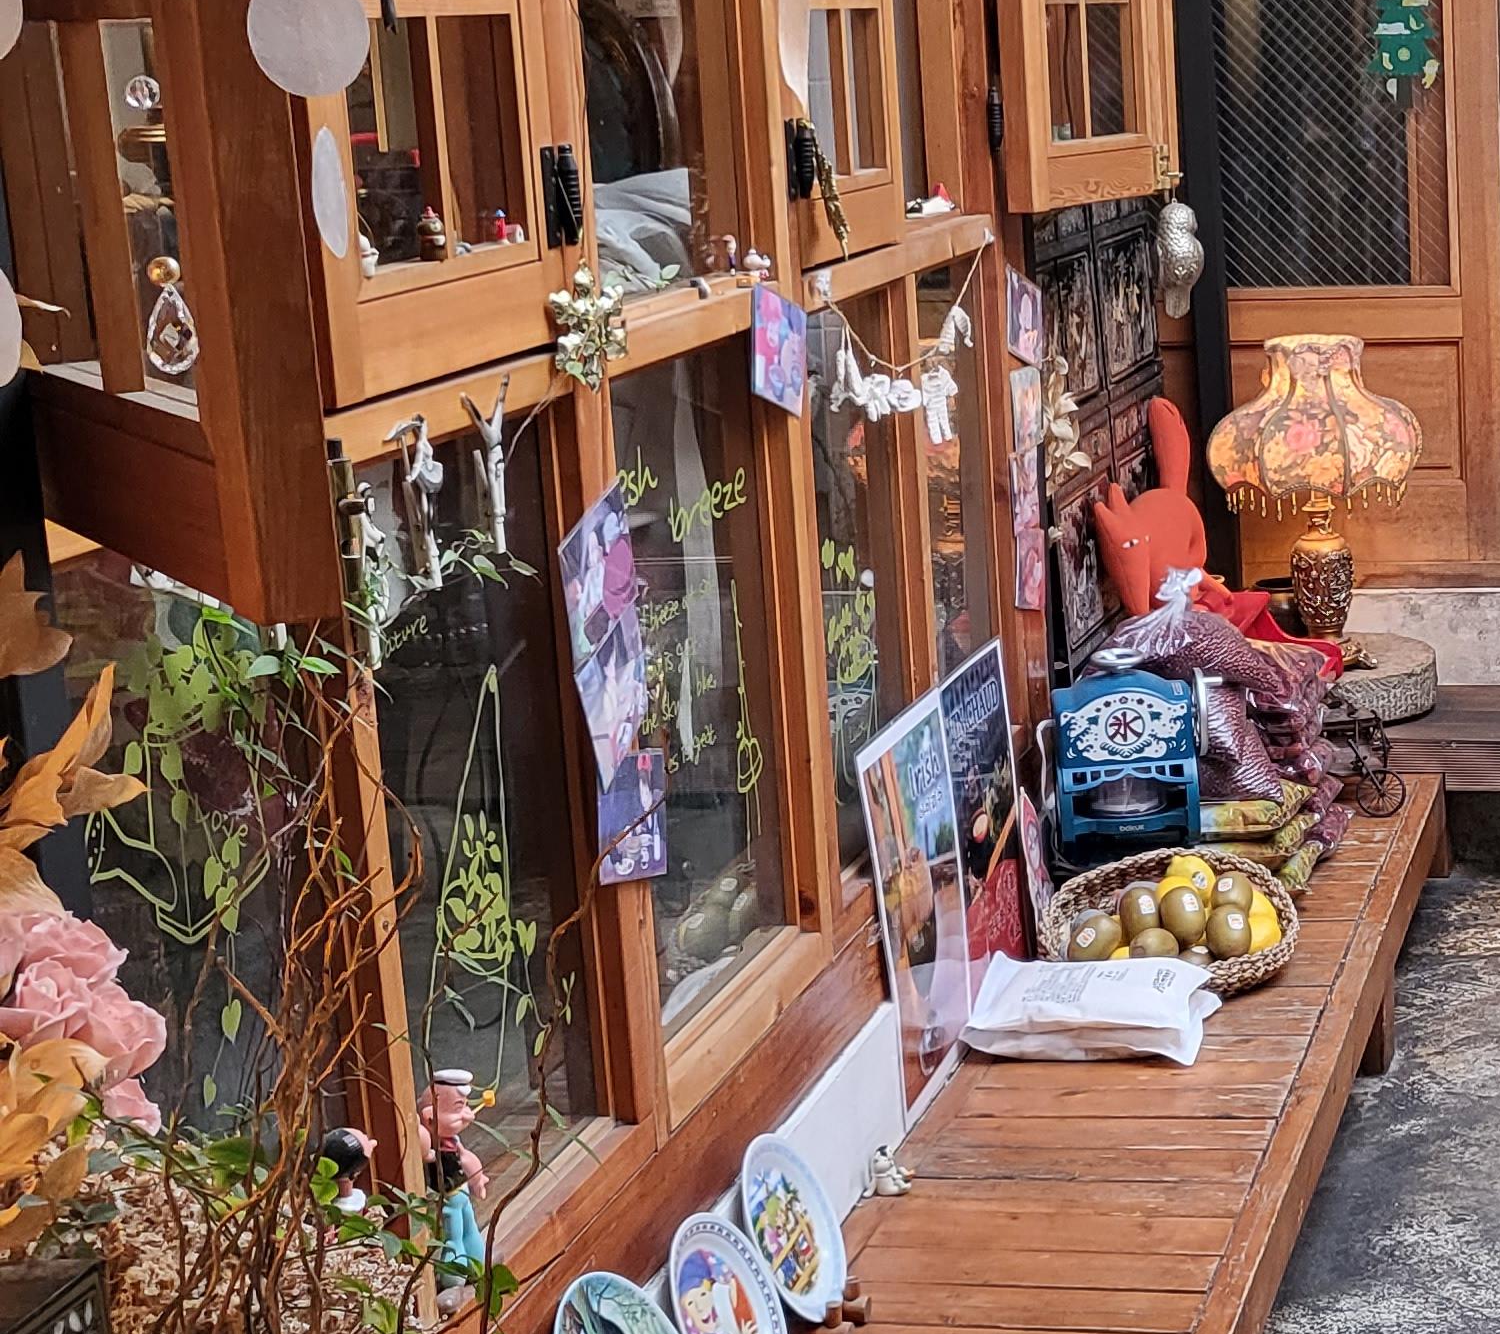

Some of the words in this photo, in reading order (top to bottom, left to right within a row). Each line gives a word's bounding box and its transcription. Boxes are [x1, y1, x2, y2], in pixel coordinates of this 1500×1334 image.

[617, 445, 659, 507] esh
[667, 466, 748, 544] breeze
[385, 614, 429, 659] ature
[908, 744, 942, 801] Irish
